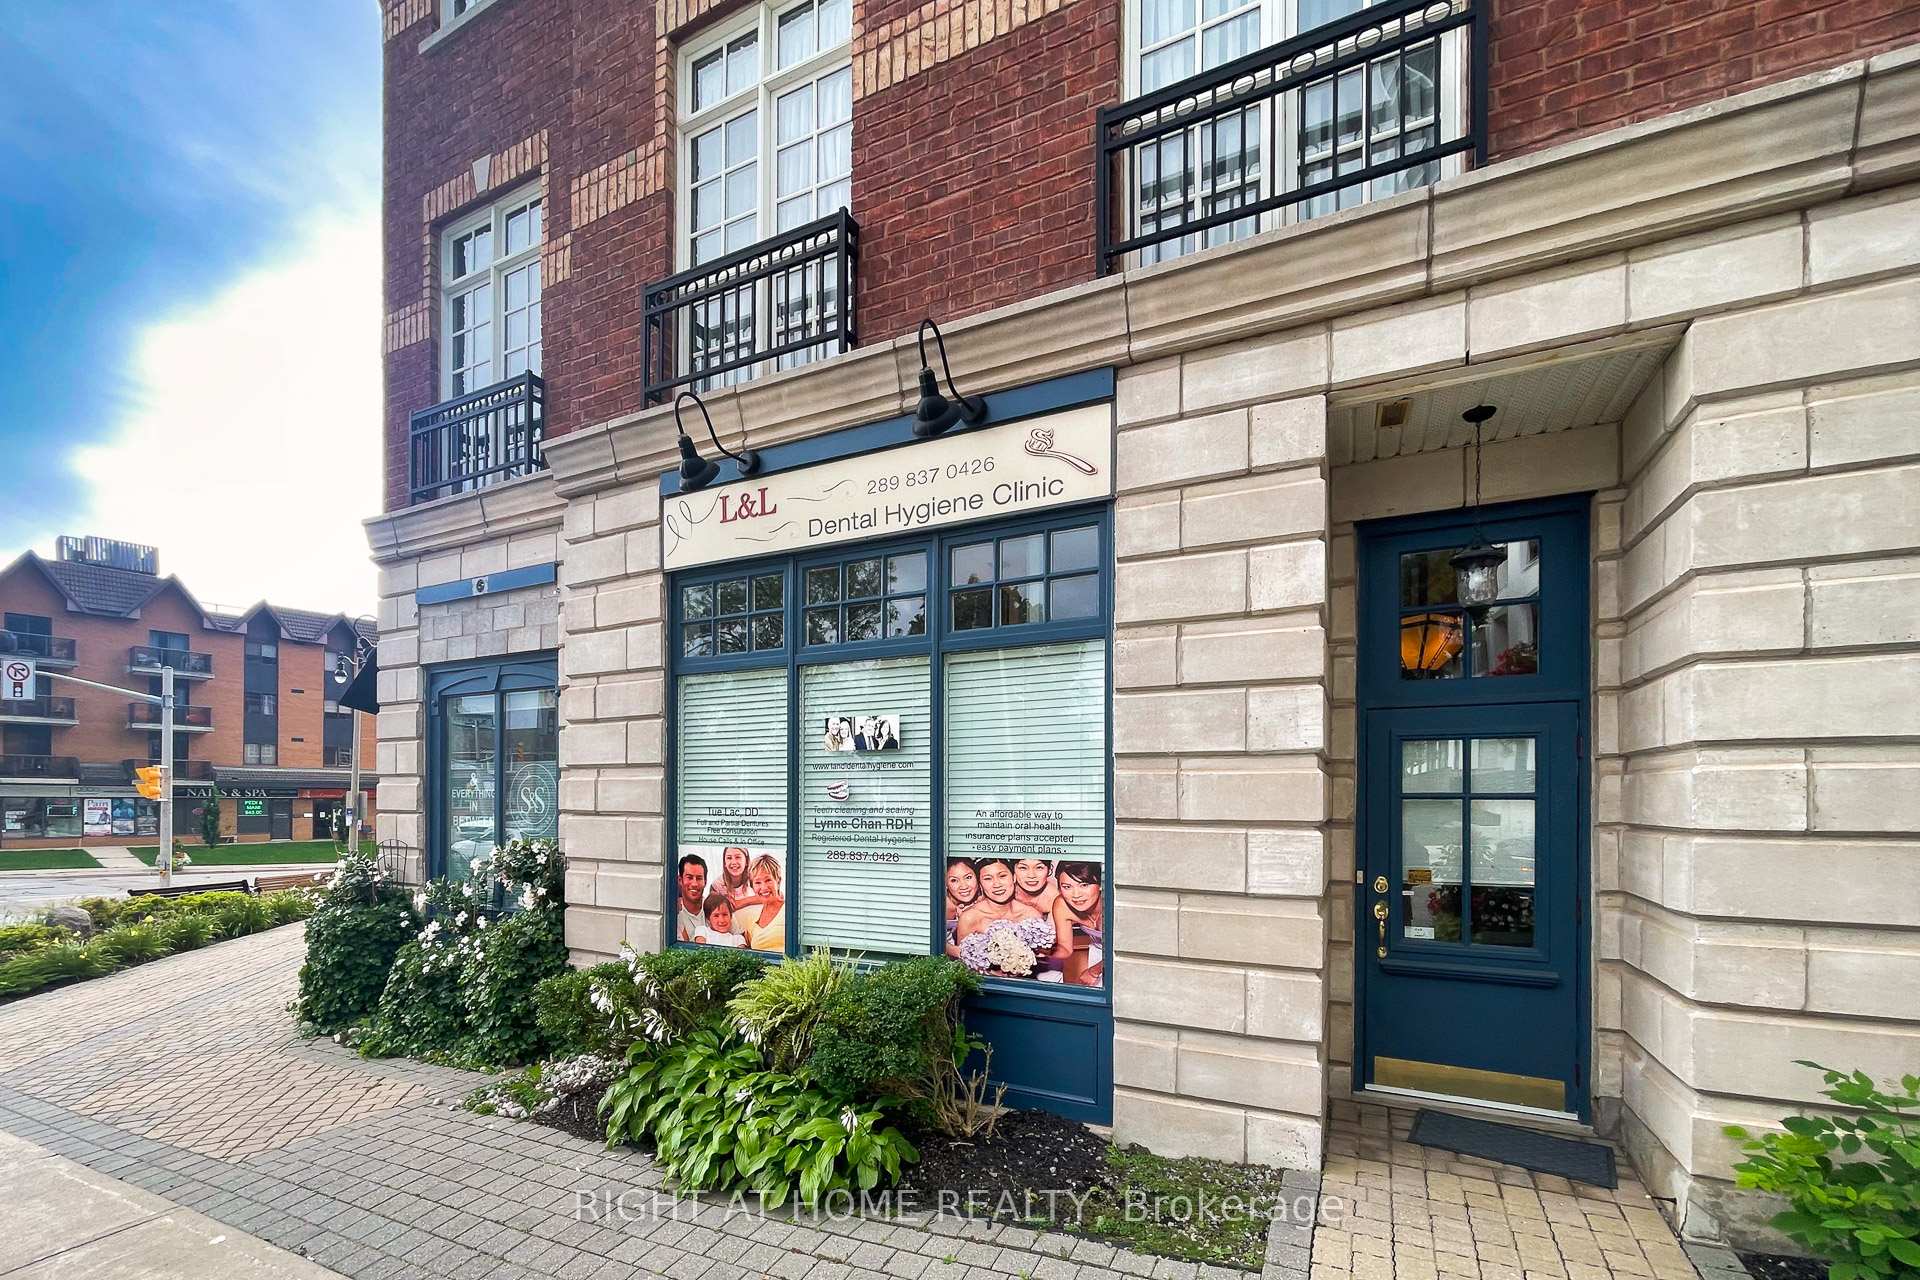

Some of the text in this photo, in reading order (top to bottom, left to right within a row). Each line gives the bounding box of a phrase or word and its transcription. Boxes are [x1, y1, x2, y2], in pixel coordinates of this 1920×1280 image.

[866, 456, 996, 496] 289 837 0426
[719, 487, 777, 524] L&L
[808, 476, 1065, 538] Dental Hygiene Clinic
[187, 788, 228, 797] NAIS
[231, 788, 241, 797] &
[245, 788, 267, 797] SPA
[975, 809, 1063, 820] An affordable way to
[814, 818, 913, 831] Lynne Chan RDH
[1015, 822, 1031, 830] oral
[811, 833, 851, 843] Registered
[854, 834, 879, 843] Dental
[965, 833, 1074, 843] insurance plans accepted
[976, 844, 1062, 854] easy payment plans
[826, 850, 900, 862] 289.837.0426
